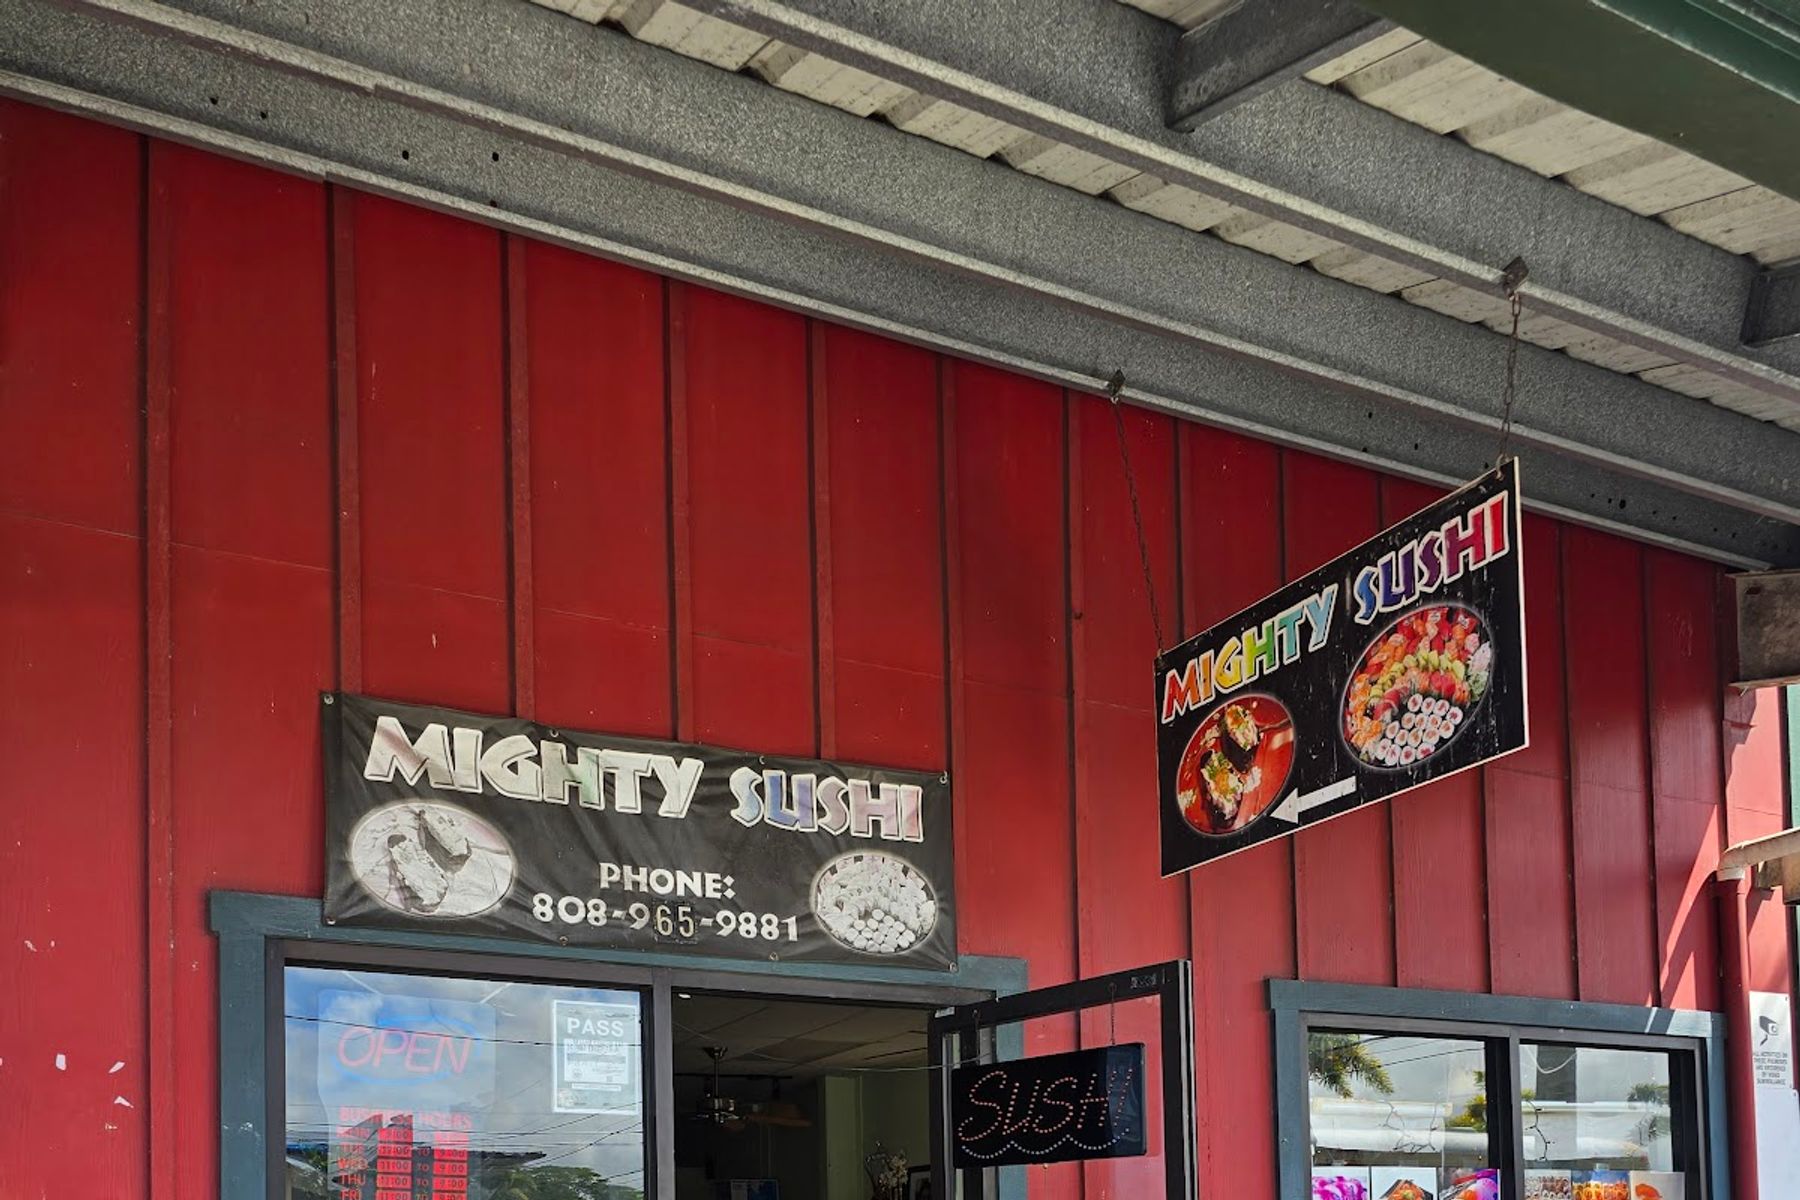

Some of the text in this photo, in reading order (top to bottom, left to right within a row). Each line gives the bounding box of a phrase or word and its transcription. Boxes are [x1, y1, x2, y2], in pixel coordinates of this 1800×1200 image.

[1162, 490, 1509, 724] MIGHTY SUSHI
[364, 716, 923, 842] MIGHTY SUSHI
[599, 862, 736, 899] PHONE:
[532, 893, 799, 942] 808-965-9881
[566, 1017, 625, 1037] PASS
[337, 1028, 472, 1073] OPEN
[958, 1069, 1133, 1141] SUSHI
[341, 1173, 366, 1185] THU
[416, 1178, 429, 1187] TO
[417, 1163, 429, 1172] TO
[341, 1188, 363, 1200] FRI
